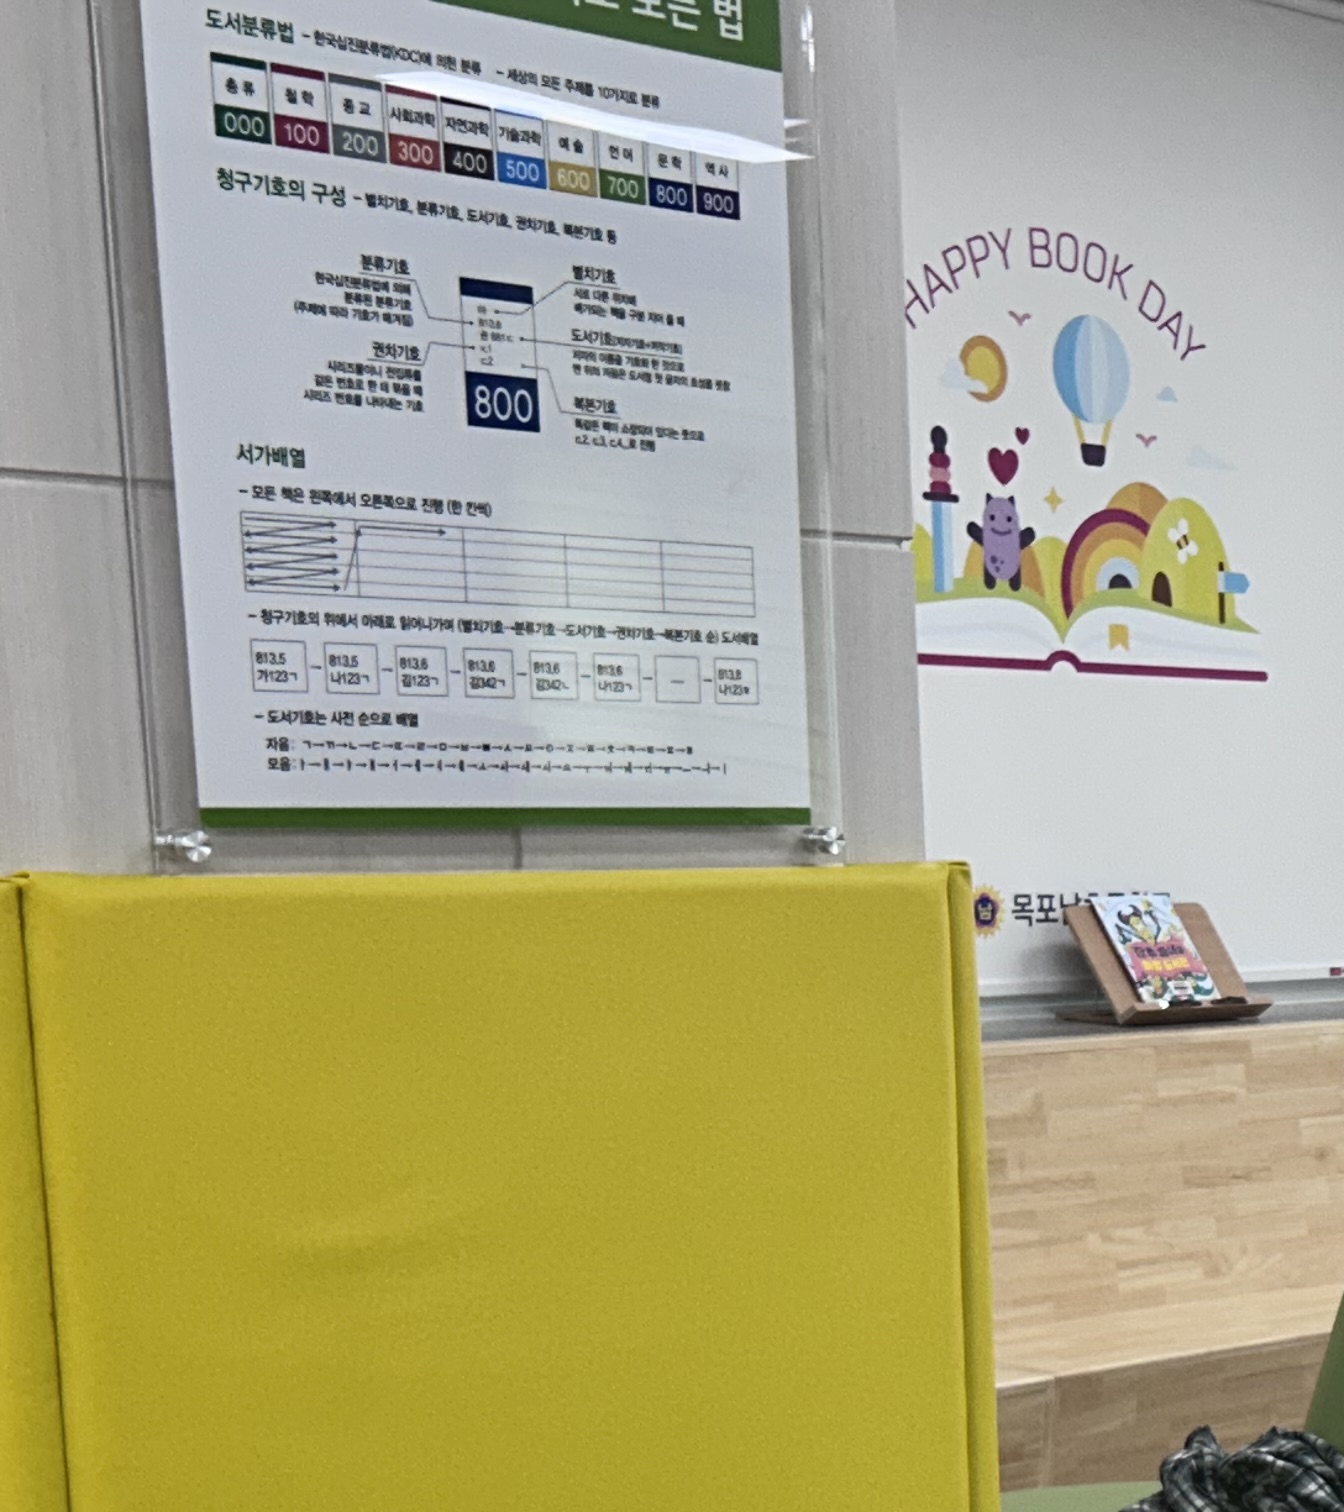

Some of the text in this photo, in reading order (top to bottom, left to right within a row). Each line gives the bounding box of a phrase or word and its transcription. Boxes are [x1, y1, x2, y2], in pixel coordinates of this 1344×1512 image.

[205, 8, 295, 44] 도서분류법
[224, 111, 265, 137] 000
[284, 123, 320, 147] 100
[342, 131, 379, 156] 200
[398, 141, 434, 166] 300
[453, 151, 488, 174] 400
[506, 160, 540, 183] 500
[217, 167, 346, 208] 청구기호의 구성
[557, 169, 590, 191] 600
[609, 176, 639, 199] 700
[655, 185, 688, 210] 800
[703, 192, 735, 215] 900
[360, 253, 410, 275] 분류기호
[904, 227, 1207, 361] HAPPY BOOK DAY
[371, 340, 422, 362] 권차기호
[474, 384, 533, 424] 800
[236, 443, 306, 469] 서가배열
[251, 484, 276, 501] 모든
[360, 493, 418, 512] 오른쪽으로
[261, 608, 320, 627] 청구기호의
[267, 709, 328, 726] 도서기호는
[330, 711, 354, 727] 사전
[357, 711, 392, 727] 순으로
